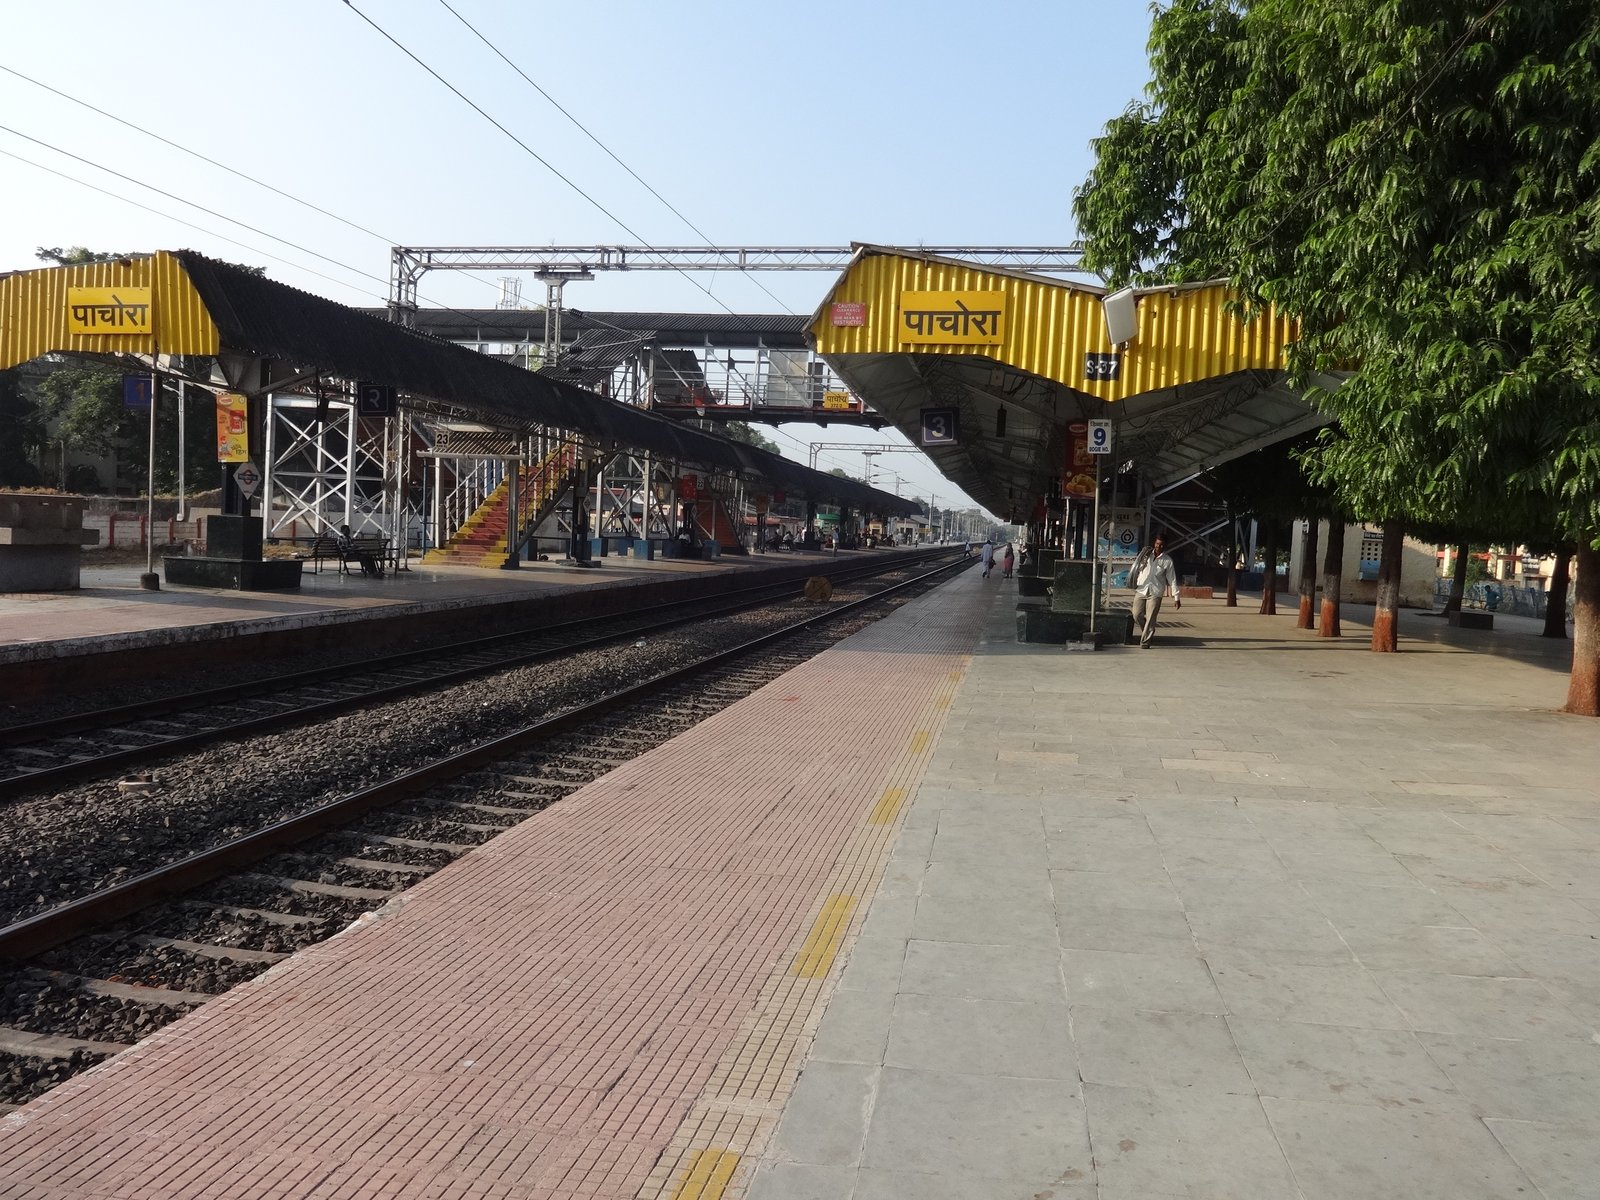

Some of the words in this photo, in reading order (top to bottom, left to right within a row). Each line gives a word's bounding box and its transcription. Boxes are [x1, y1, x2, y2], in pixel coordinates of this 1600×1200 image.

[72, 294, 149, 327] पाचोरा
[903, 299, 1002, 337] पाचोरा
[1087, 360, 1118, 375] S-37
[932, 416, 946, 438] 3
[1093, 427, 1107, 447] 9
[436, 433, 449, 445] 23
